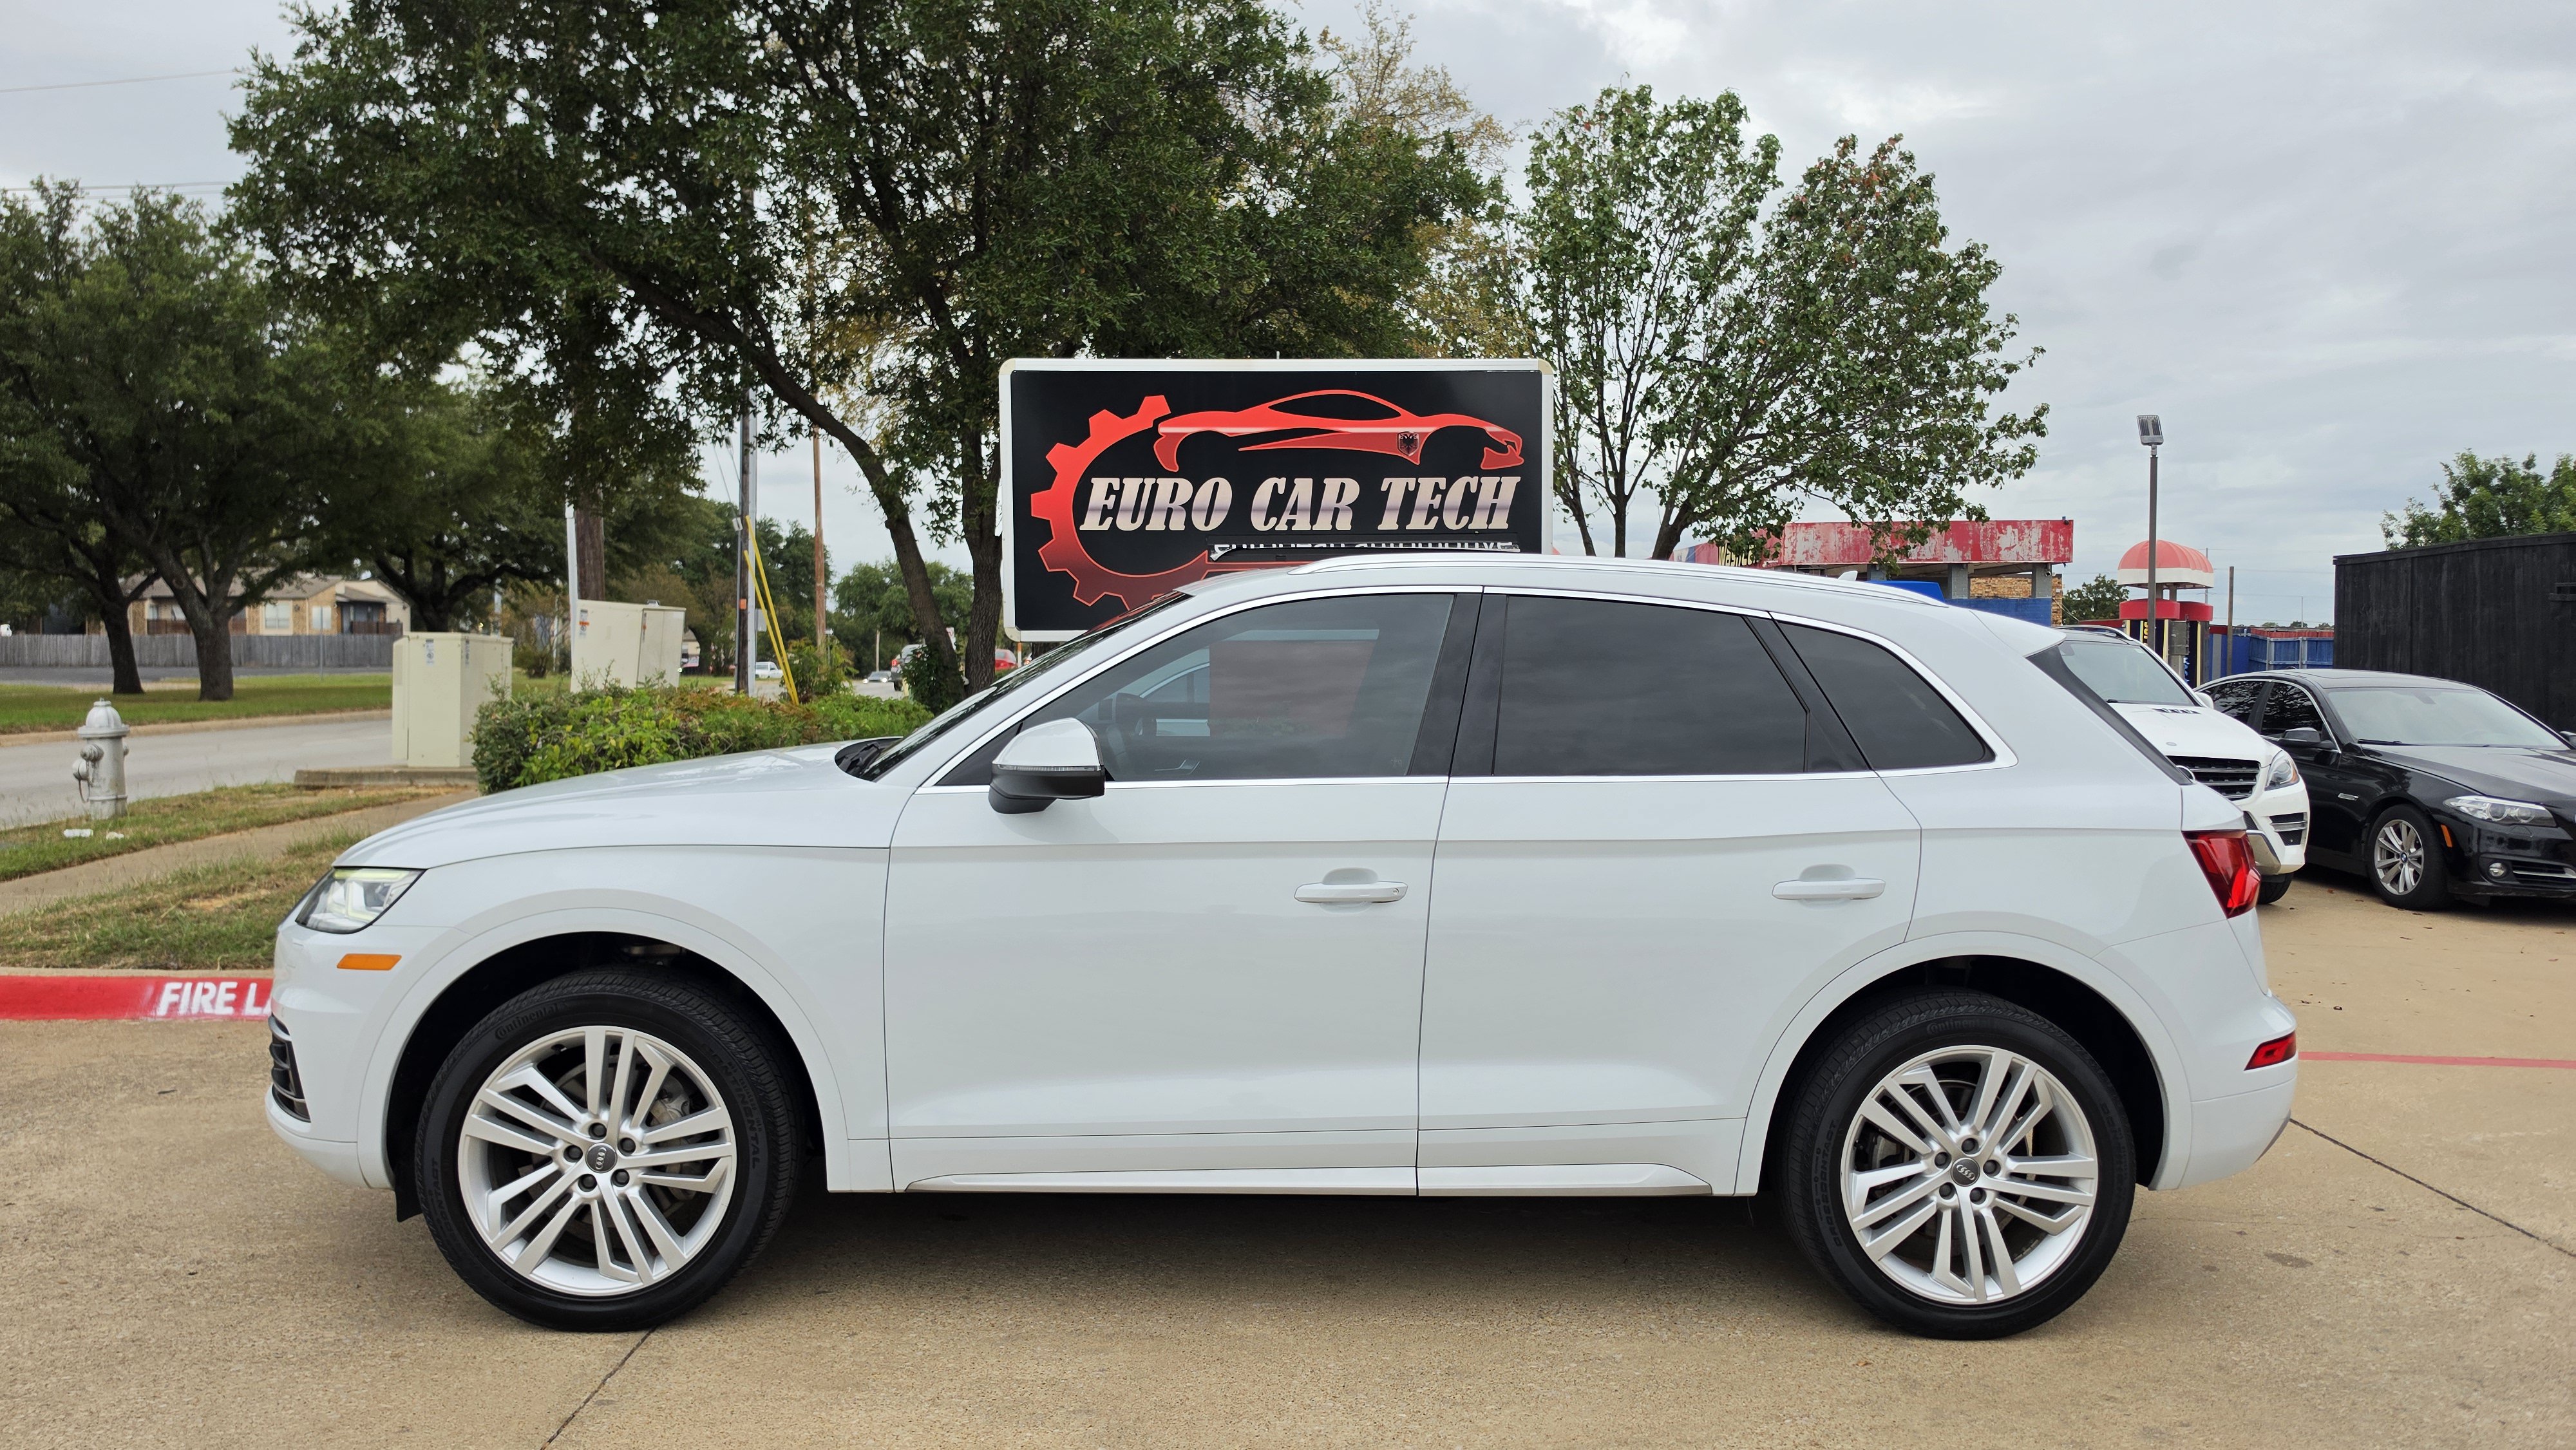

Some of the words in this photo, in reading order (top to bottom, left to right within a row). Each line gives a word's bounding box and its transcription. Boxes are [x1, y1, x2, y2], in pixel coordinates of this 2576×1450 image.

[1079, 476, 1233, 531] EURO
[1251, 476, 1360, 531] CAR
[1377, 476, 1521, 531] TECH
[156, 981, 238, 1015] FIRE
[495, 1003, 559, 1040] Continental
